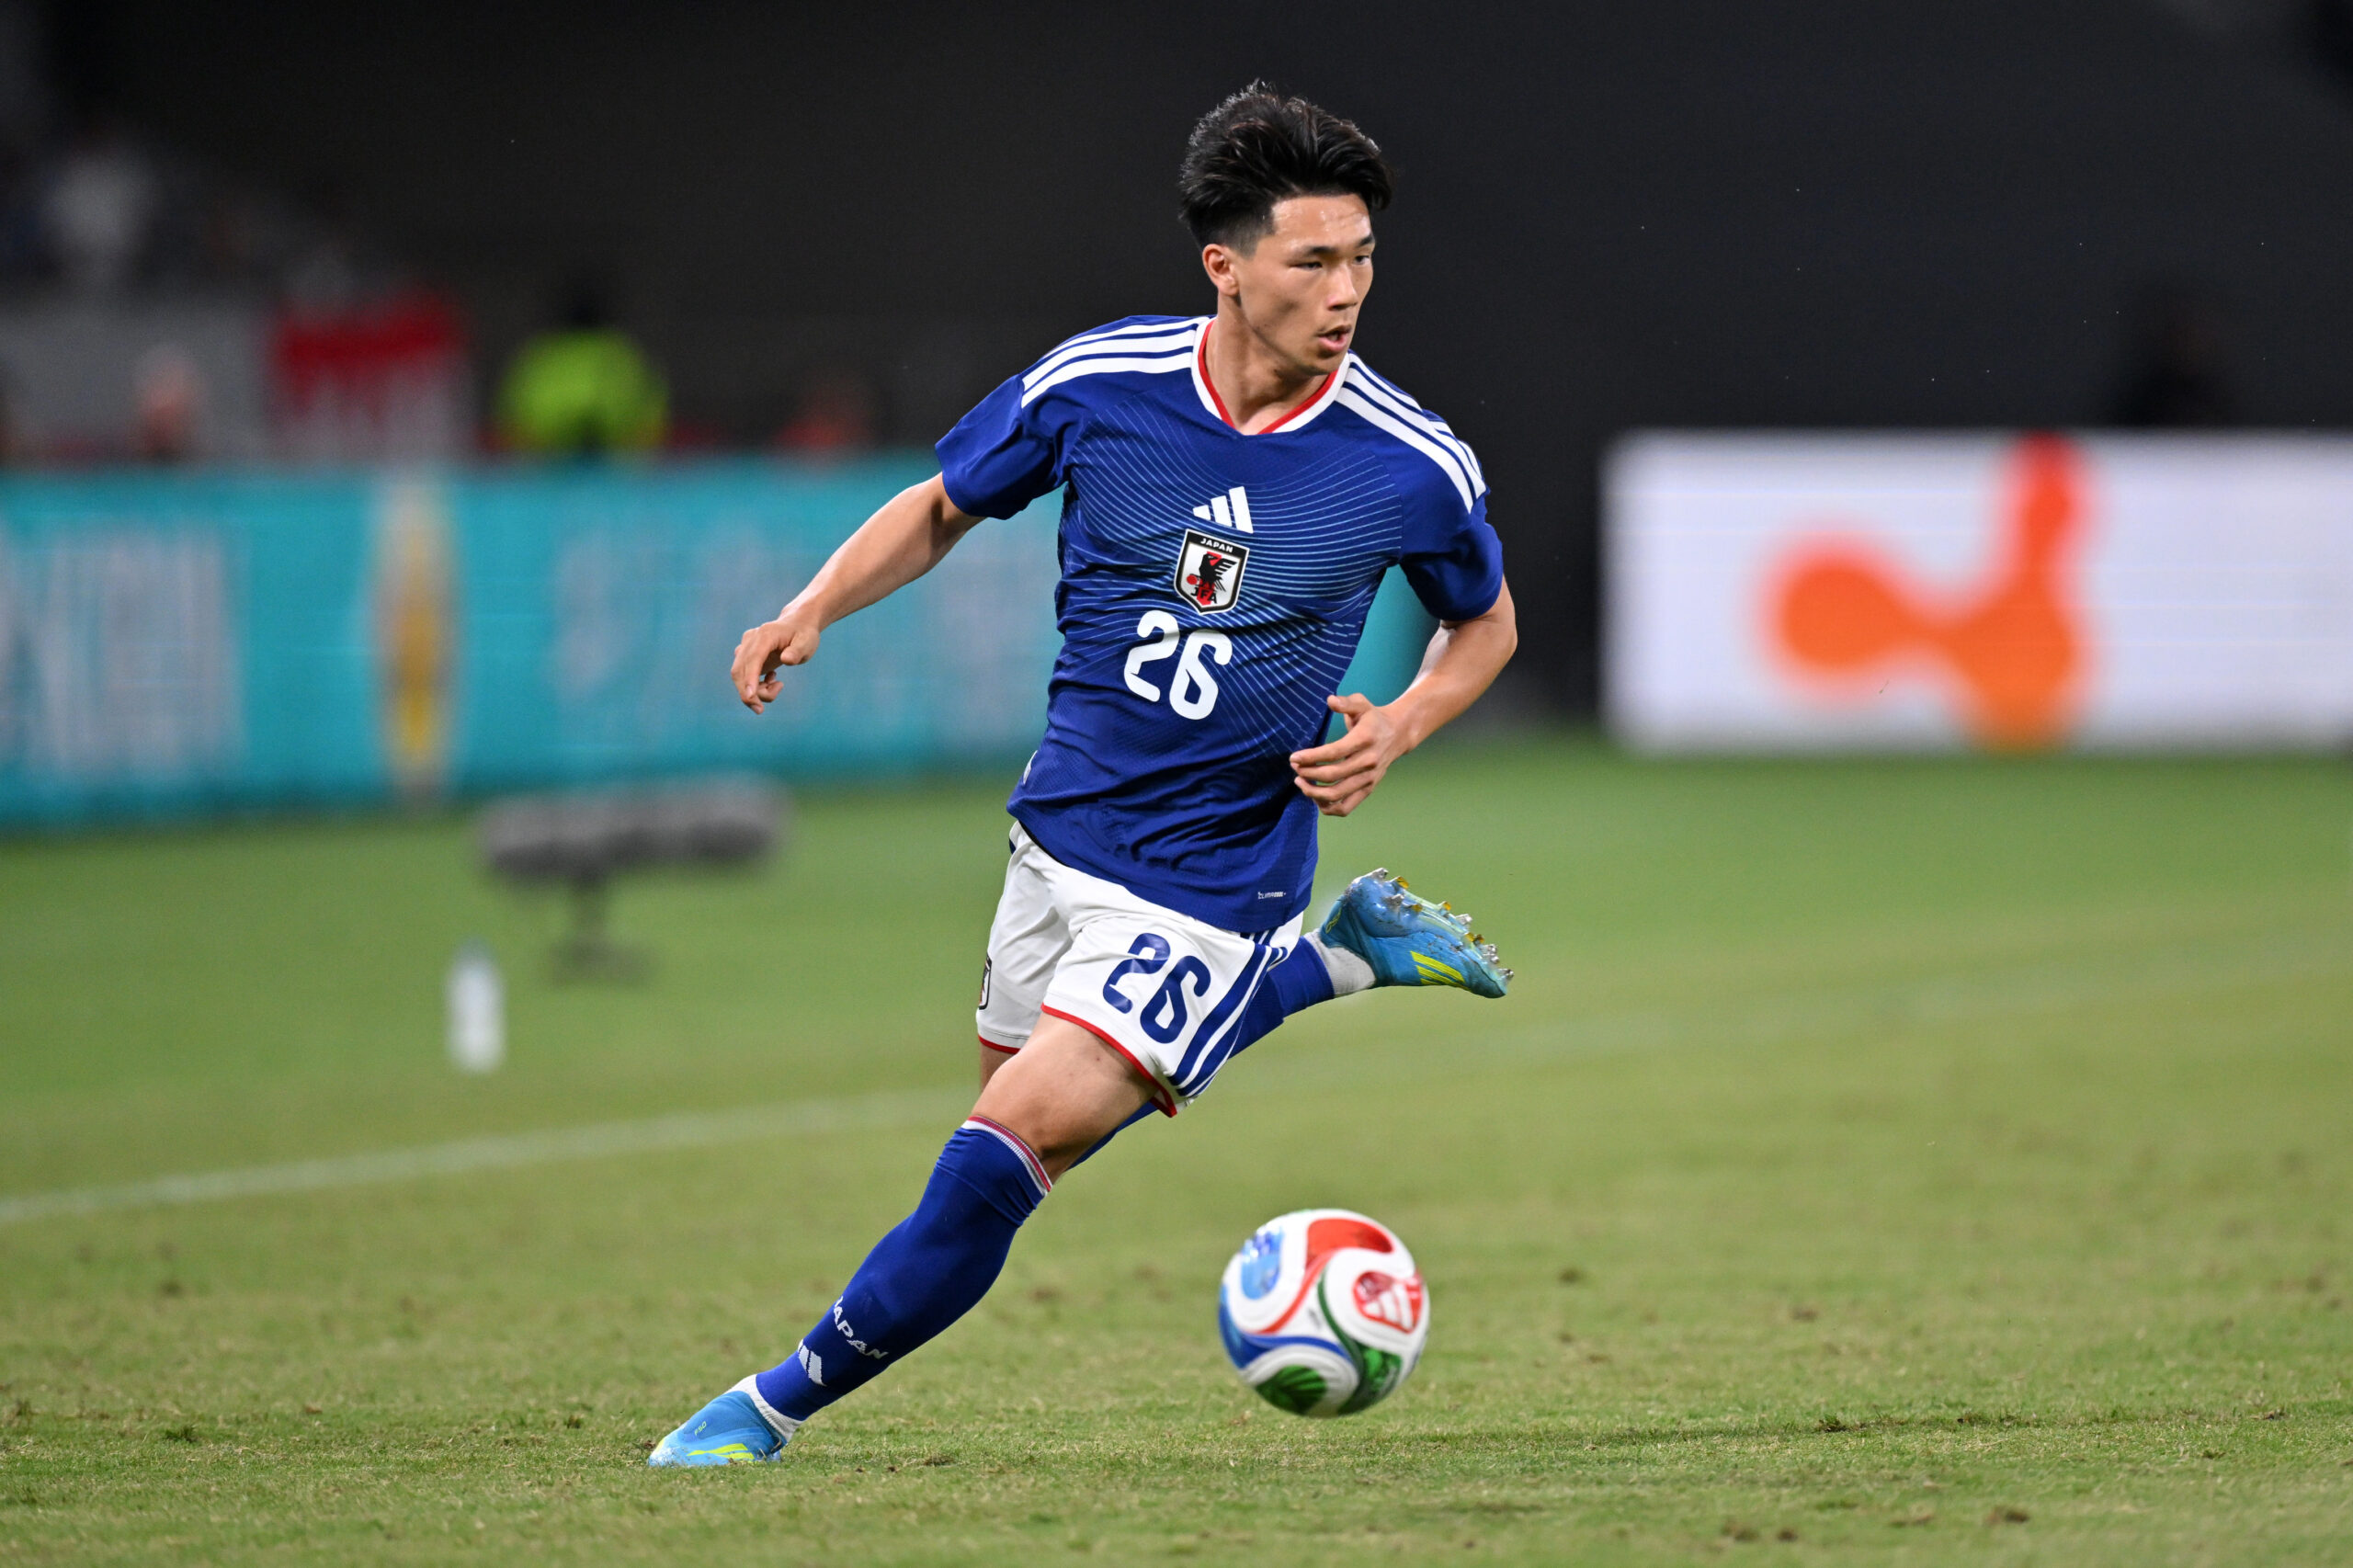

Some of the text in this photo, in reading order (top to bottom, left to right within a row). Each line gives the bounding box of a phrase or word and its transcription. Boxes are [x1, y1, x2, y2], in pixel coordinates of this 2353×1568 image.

[1200, 538, 1233, 553] JAPAN
[1190, 587, 1218, 604] JFA
[1123, 610, 1233, 720] 26
[1103, 933, 1211, 1044] 26
